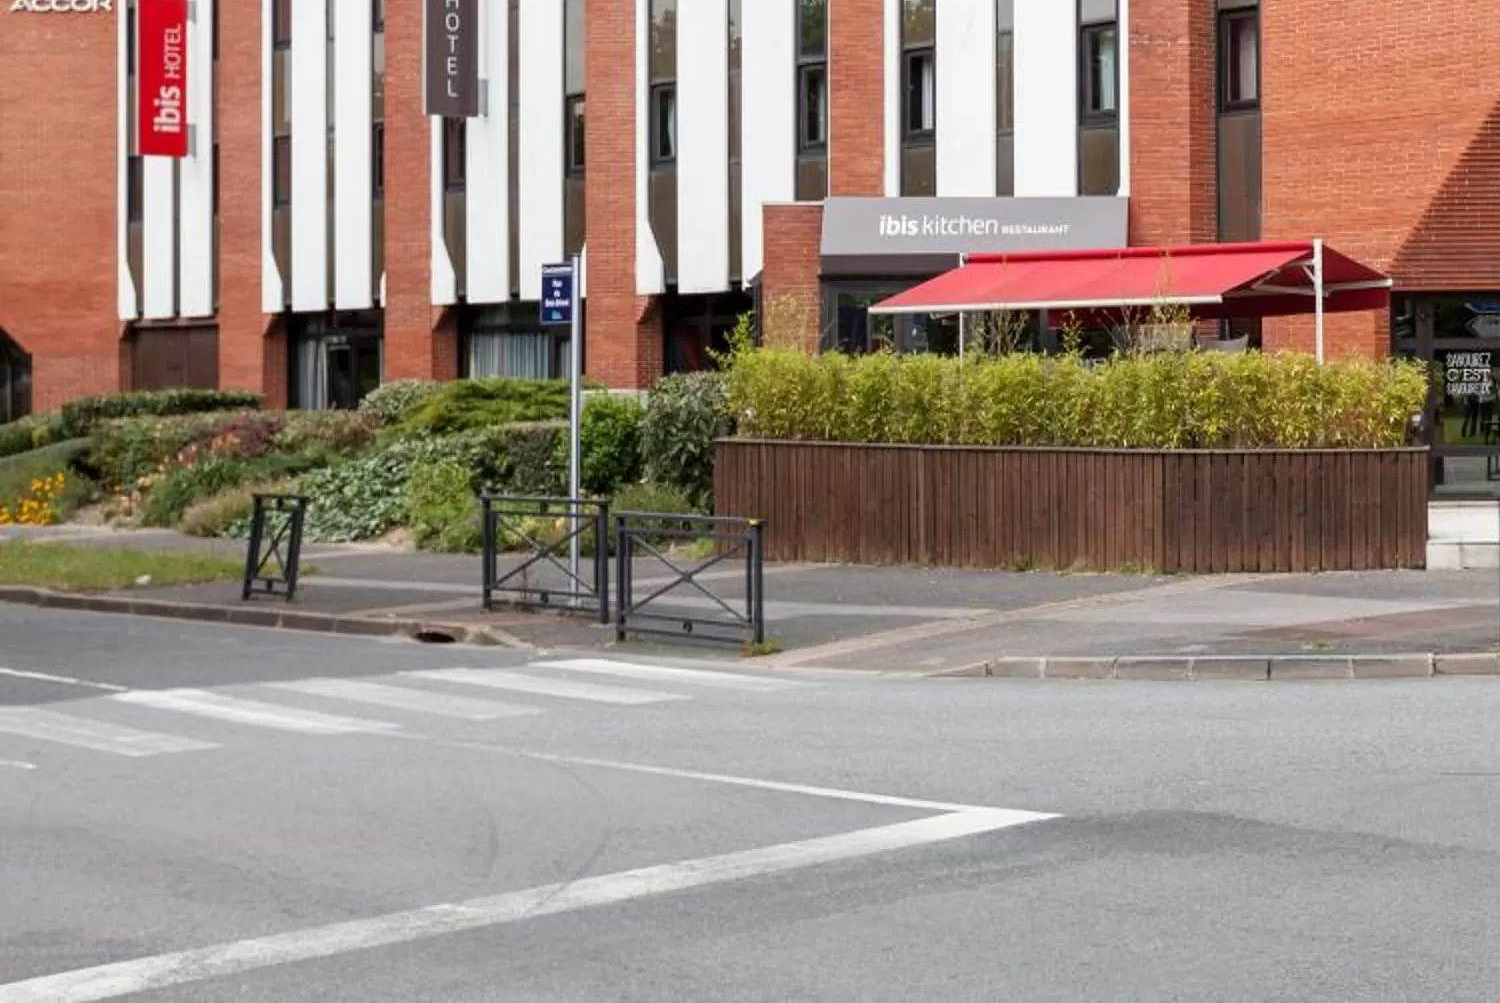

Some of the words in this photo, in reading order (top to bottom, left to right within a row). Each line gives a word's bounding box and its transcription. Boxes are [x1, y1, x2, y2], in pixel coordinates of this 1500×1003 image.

[163, 23, 181, 80] HOTEL
[153, 85, 181, 134] ibis
[879, 215, 918, 236] ibis
[922, 214, 998, 236] kitchen
[1001, 224, 1070, 235] RESTAURANT
[1447, 368, 1491, 382] C'EST
